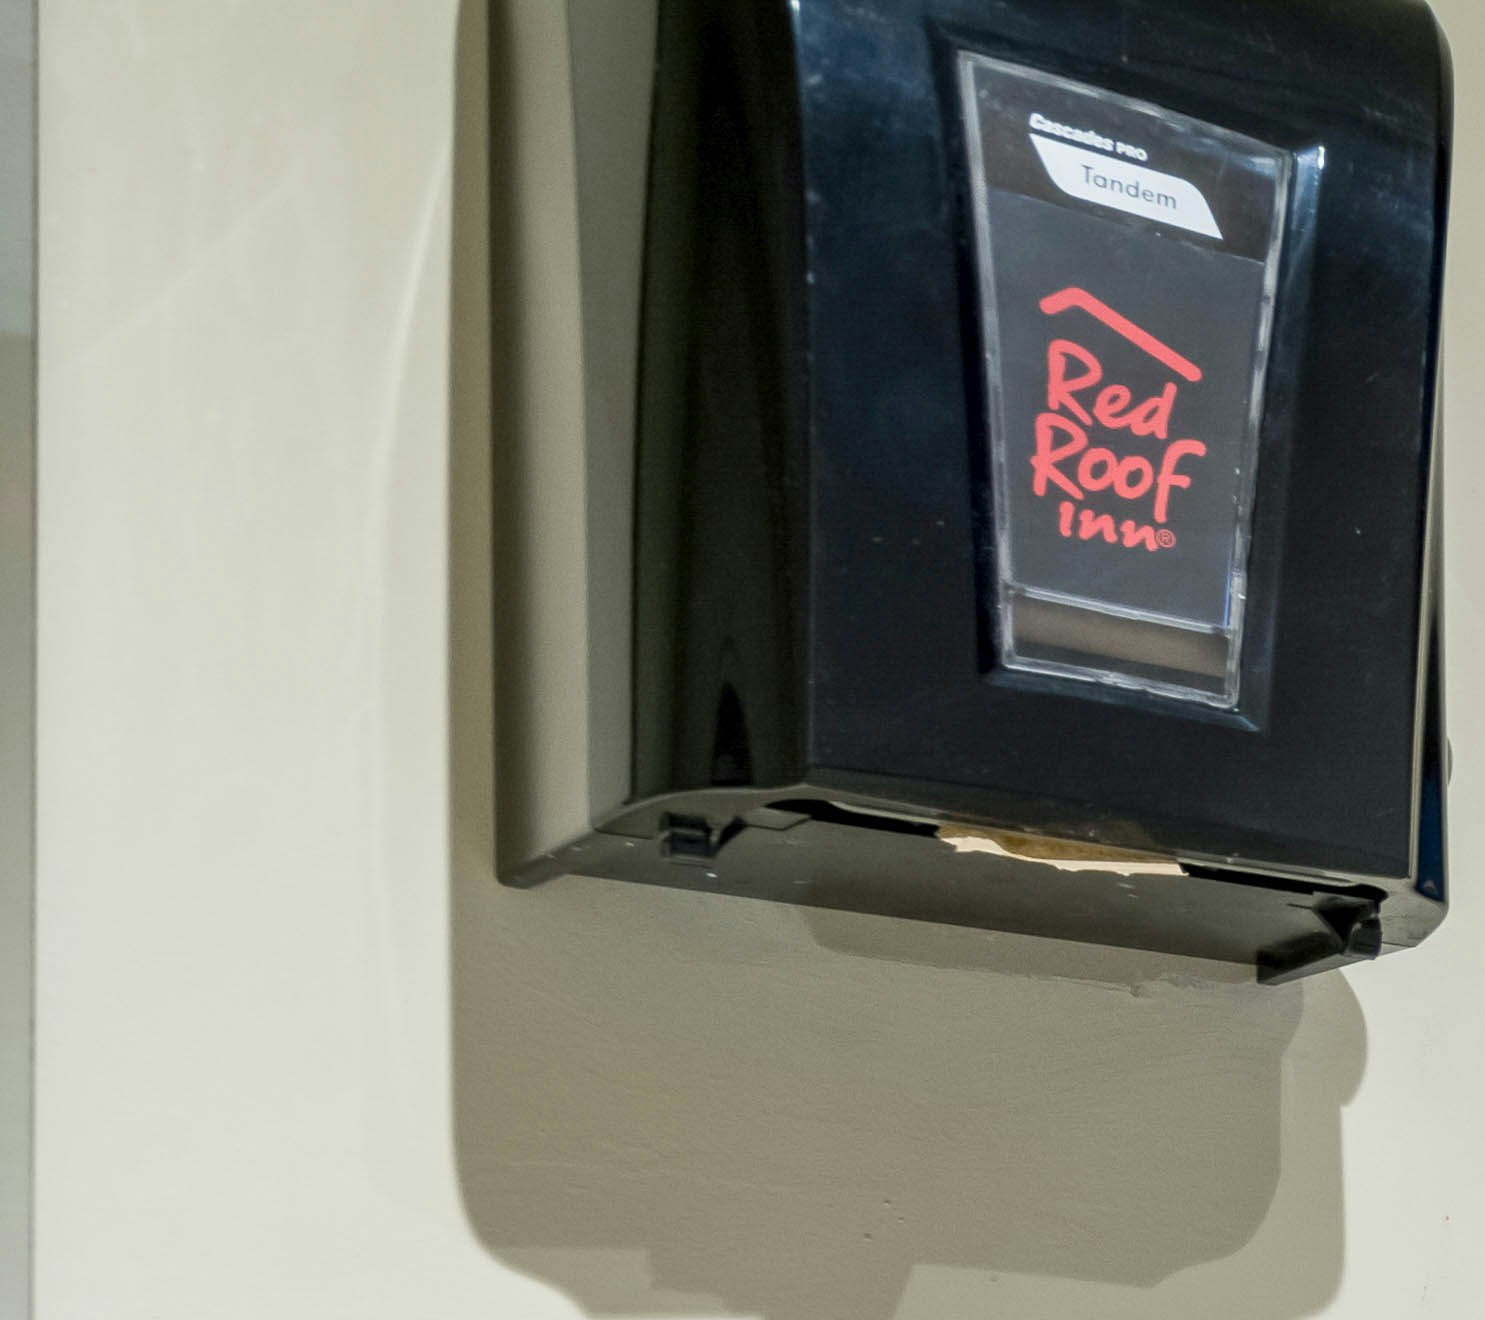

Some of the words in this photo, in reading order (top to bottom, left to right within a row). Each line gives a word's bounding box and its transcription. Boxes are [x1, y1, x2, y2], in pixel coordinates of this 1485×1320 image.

[1081, 164, 1177, 209] Tandem
[1116, 141, 1149, 161] PRO
[1047, 339, 1177, 439] Red
[1030, 413, 1205, 521] Roof
